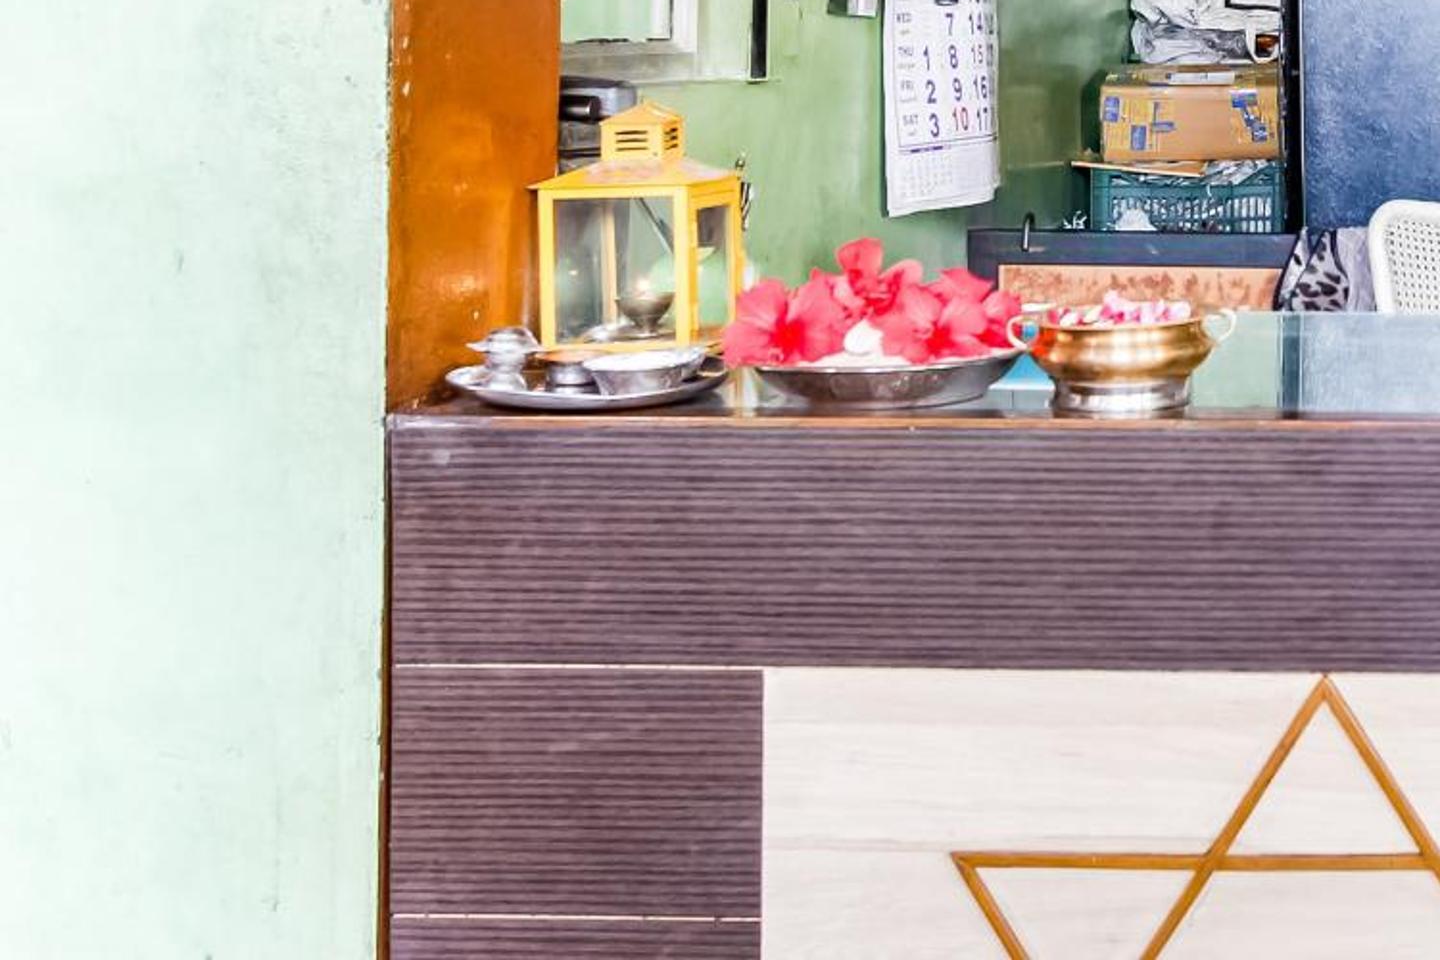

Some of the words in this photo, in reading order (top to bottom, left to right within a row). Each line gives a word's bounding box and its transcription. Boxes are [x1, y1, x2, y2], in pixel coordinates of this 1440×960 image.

[945, 13, 954, 36] 7
[968, 13, 983, 36] 14
[923, 45, 931, 71] 1
[948, 44, 959, 69] 8
[971, 43, 984, 64] 15
[925, 79, 937, 104] 2
[952, 77, 963, 102] 9
[973, 75, 988, 100] 16
[902, 114, 919, 126] SAT
[929, 112, 940, 138] 3
[952, 106, 969, 132] 10
[977, 106, 989, 132] 17
